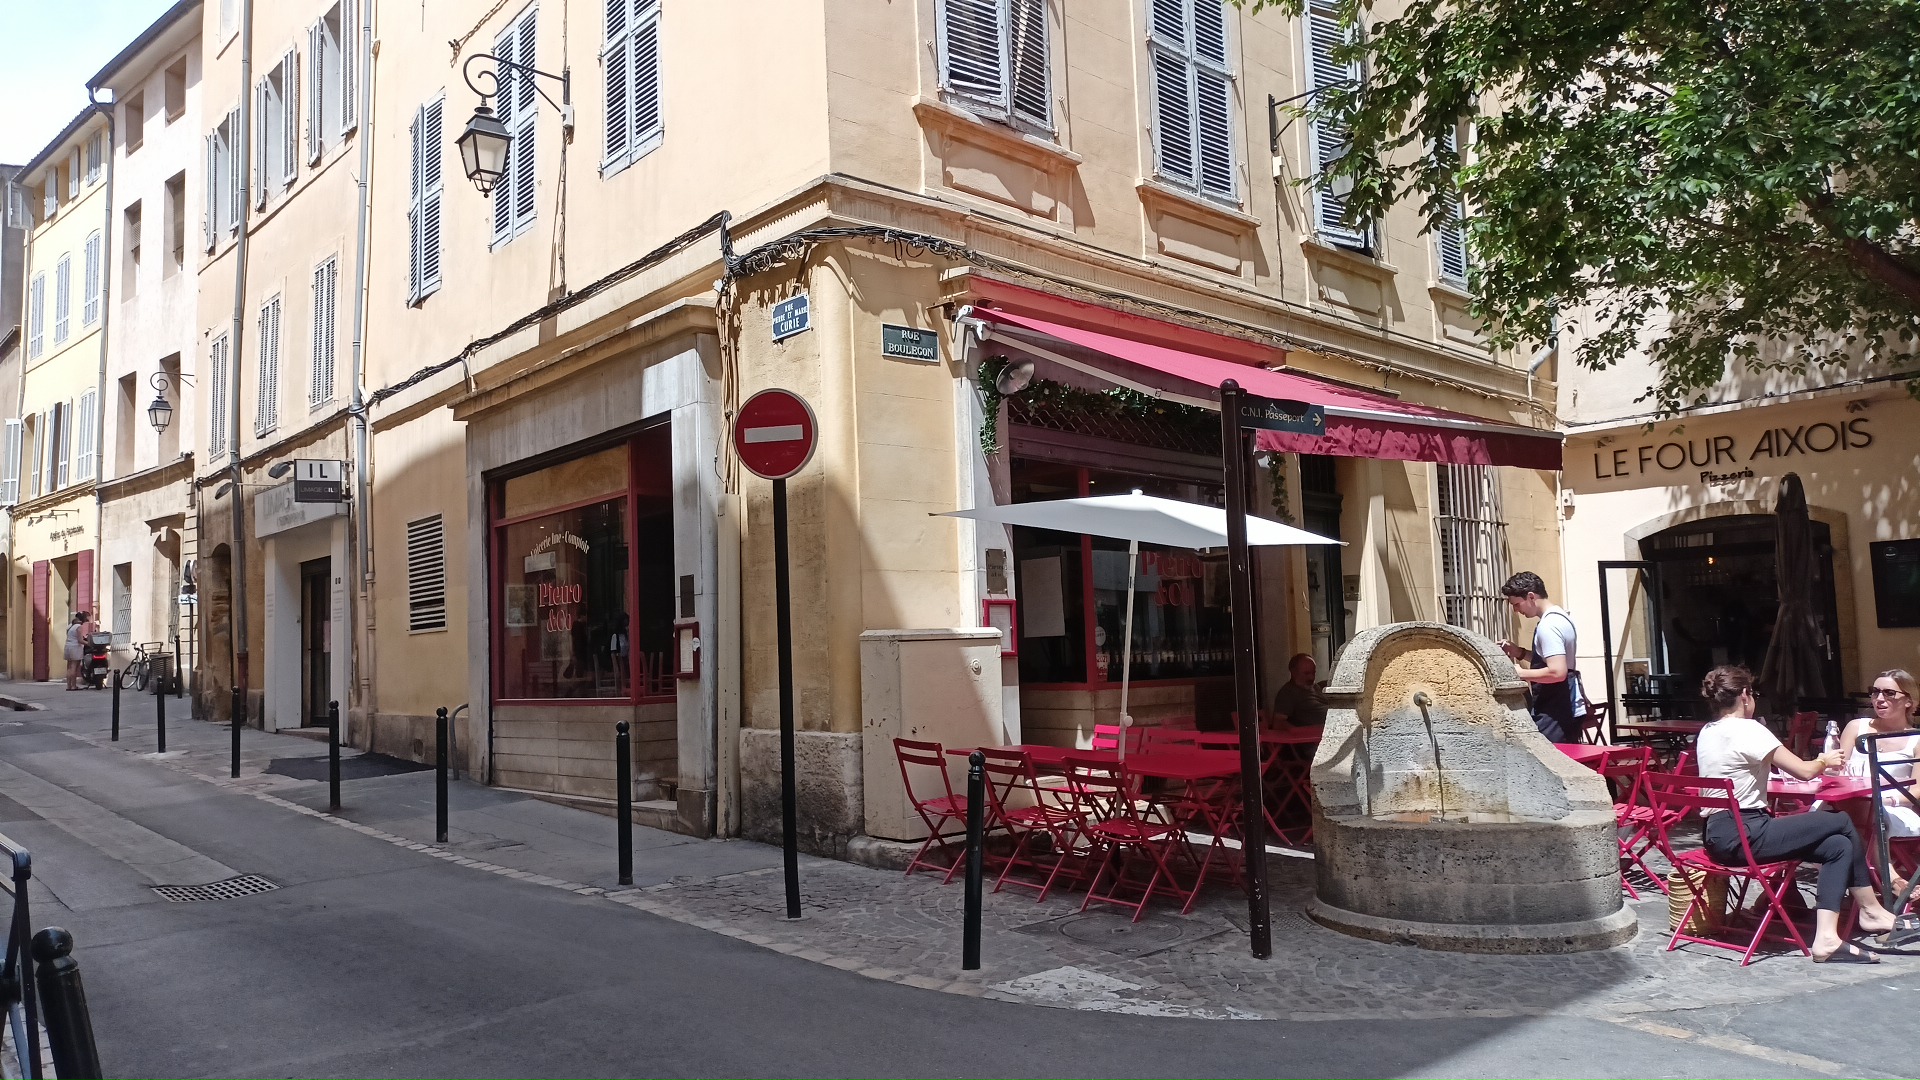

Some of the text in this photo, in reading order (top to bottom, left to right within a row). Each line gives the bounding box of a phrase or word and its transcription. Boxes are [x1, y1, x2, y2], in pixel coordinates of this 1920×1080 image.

[785, 303, 794, 312] RUE
[787, 311, 792, 319] ET
[794, 306, 808, 317] MARIE
[780, 317, 800, 332] CURIE
[901, 329, 920, 341] RUE
[887, 342, 934, 357] BOULEGON
[1241, 406, 1304, 424] C.N.I. Passeport
[1593, 418, 1873, 479] LE FOUR AIXOIS
[1700, 466, 1754, 483] Pizzeria
[564, 531, 590, 554] Comptoir
[1141, 550, 1204, 578] Pietro
[538, 580, 583, 607] Pietro
